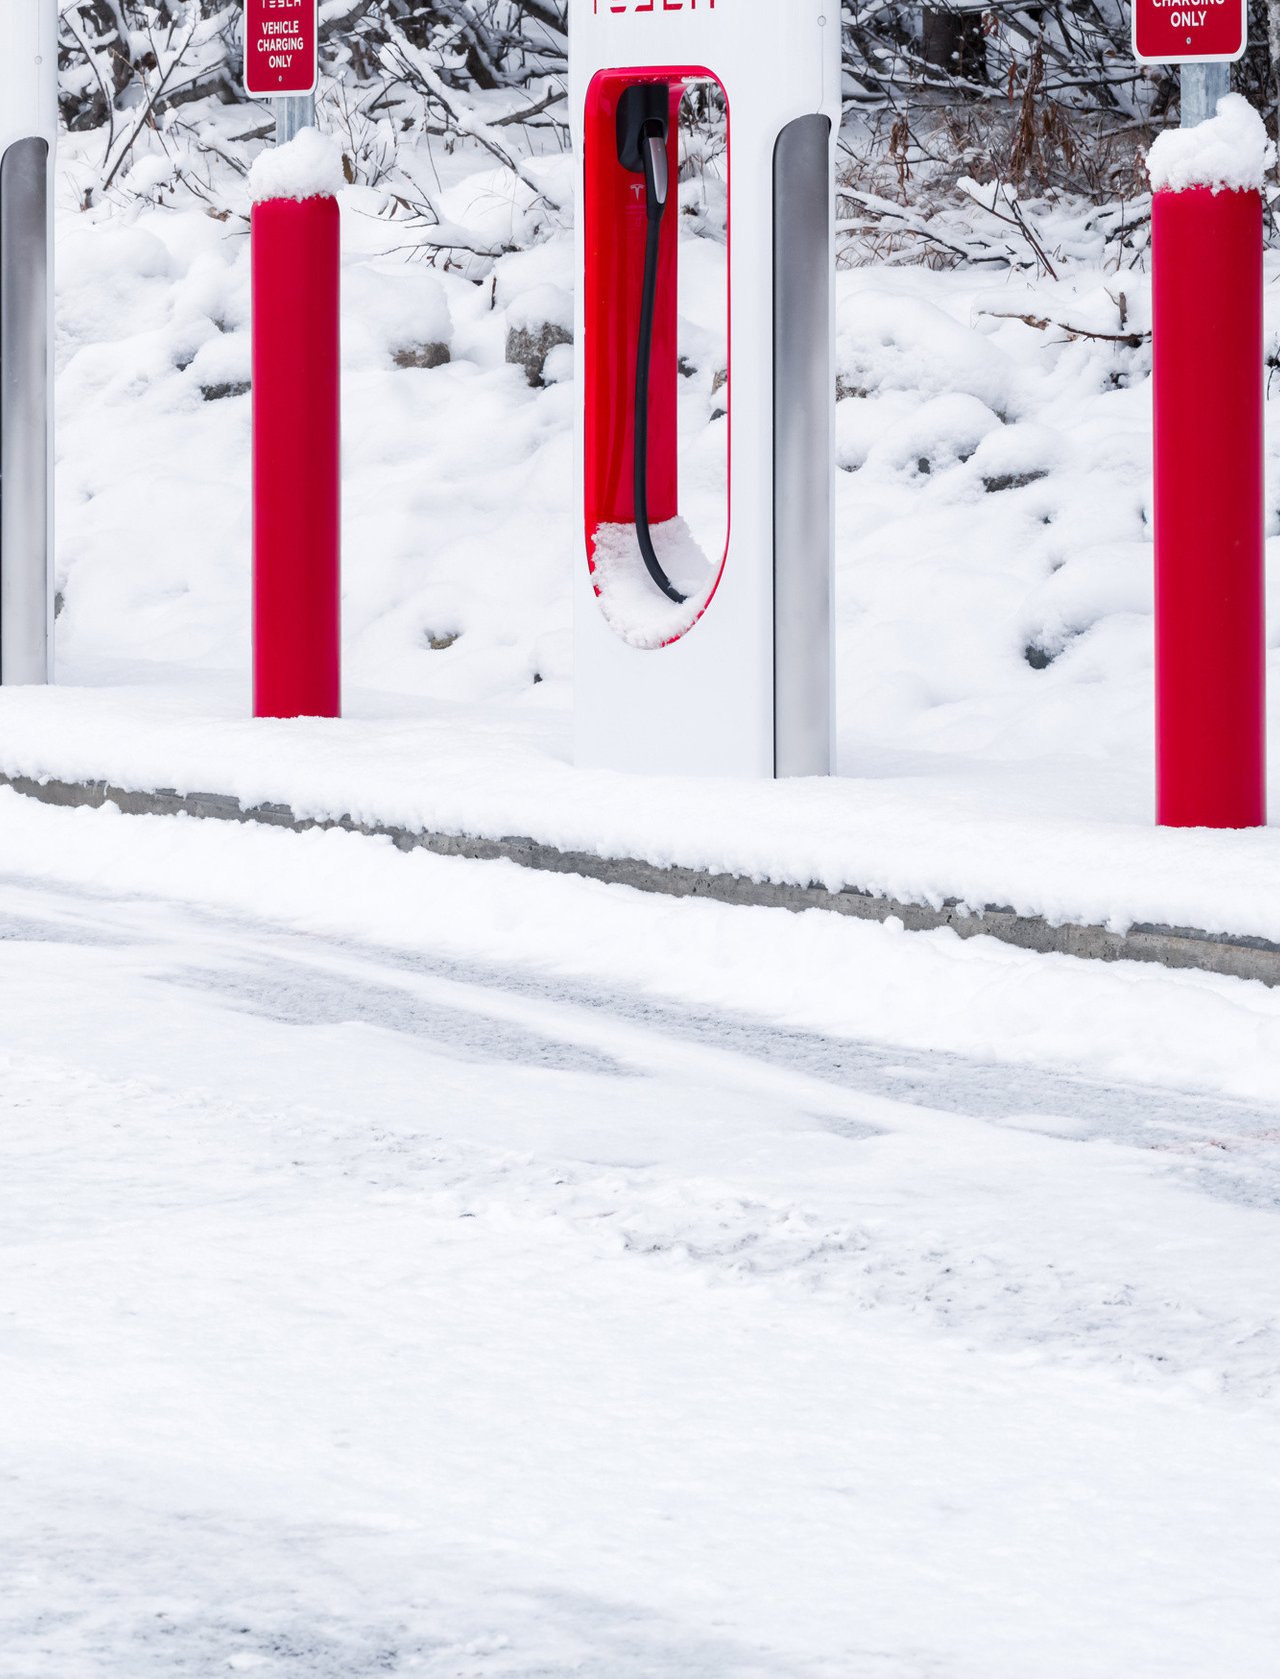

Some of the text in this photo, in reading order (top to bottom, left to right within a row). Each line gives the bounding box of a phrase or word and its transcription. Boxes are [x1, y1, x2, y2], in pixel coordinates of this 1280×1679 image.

[1170, 10, 1207, 28] ONLY
[261, 20, 299, 35] VEHICLE
[257, 36, 304, 52] CHARGING
[268, 54, 293, 69] ONLY
